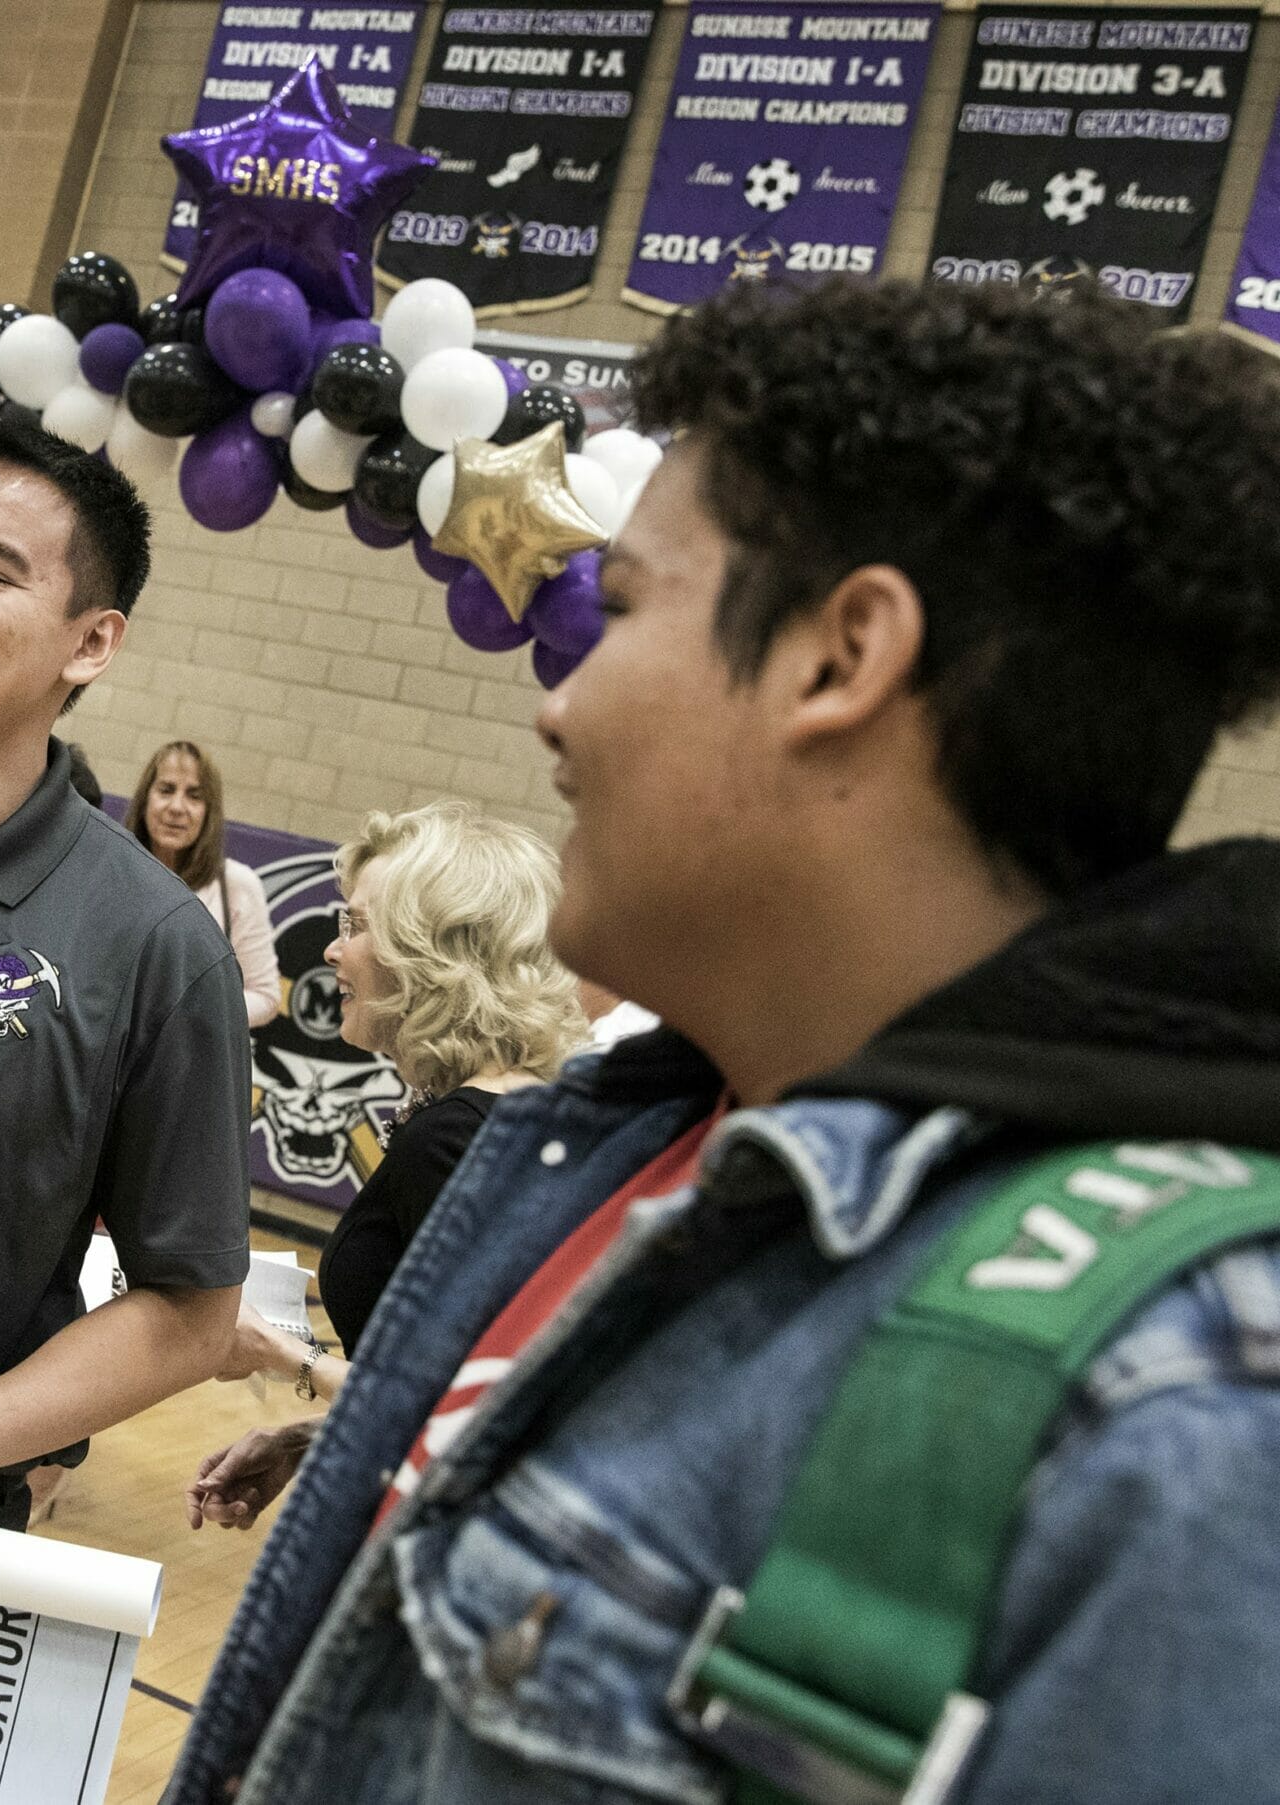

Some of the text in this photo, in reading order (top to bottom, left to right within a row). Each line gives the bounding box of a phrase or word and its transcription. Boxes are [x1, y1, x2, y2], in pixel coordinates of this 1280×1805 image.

[309, 8, 417, 33] MOUNTAIN
[691, 14, 931, 42] SUNRISE MOUNTAIN
[977, 17, 1252, 52] SUNRISE MOUNTAIN
[443, 45, 570, 76] DIVISION
[694, 53, 836, 86] DIVISION
[978, 58, 1227, 98] DIVISION 3-A
[675, 94, 909, 127] REGION CHAMPIONS
[958, 103, 1233, 143] DIVISION CHAMPIONS
[230, 154, 342, 205] SMHS
[388, 210, 600, 257] 2013 2014
[639, 232, 878, 275] 2014 2015
[1098, 264, 1196, 308] 2017
[562, 359, 634, 391] SUN
